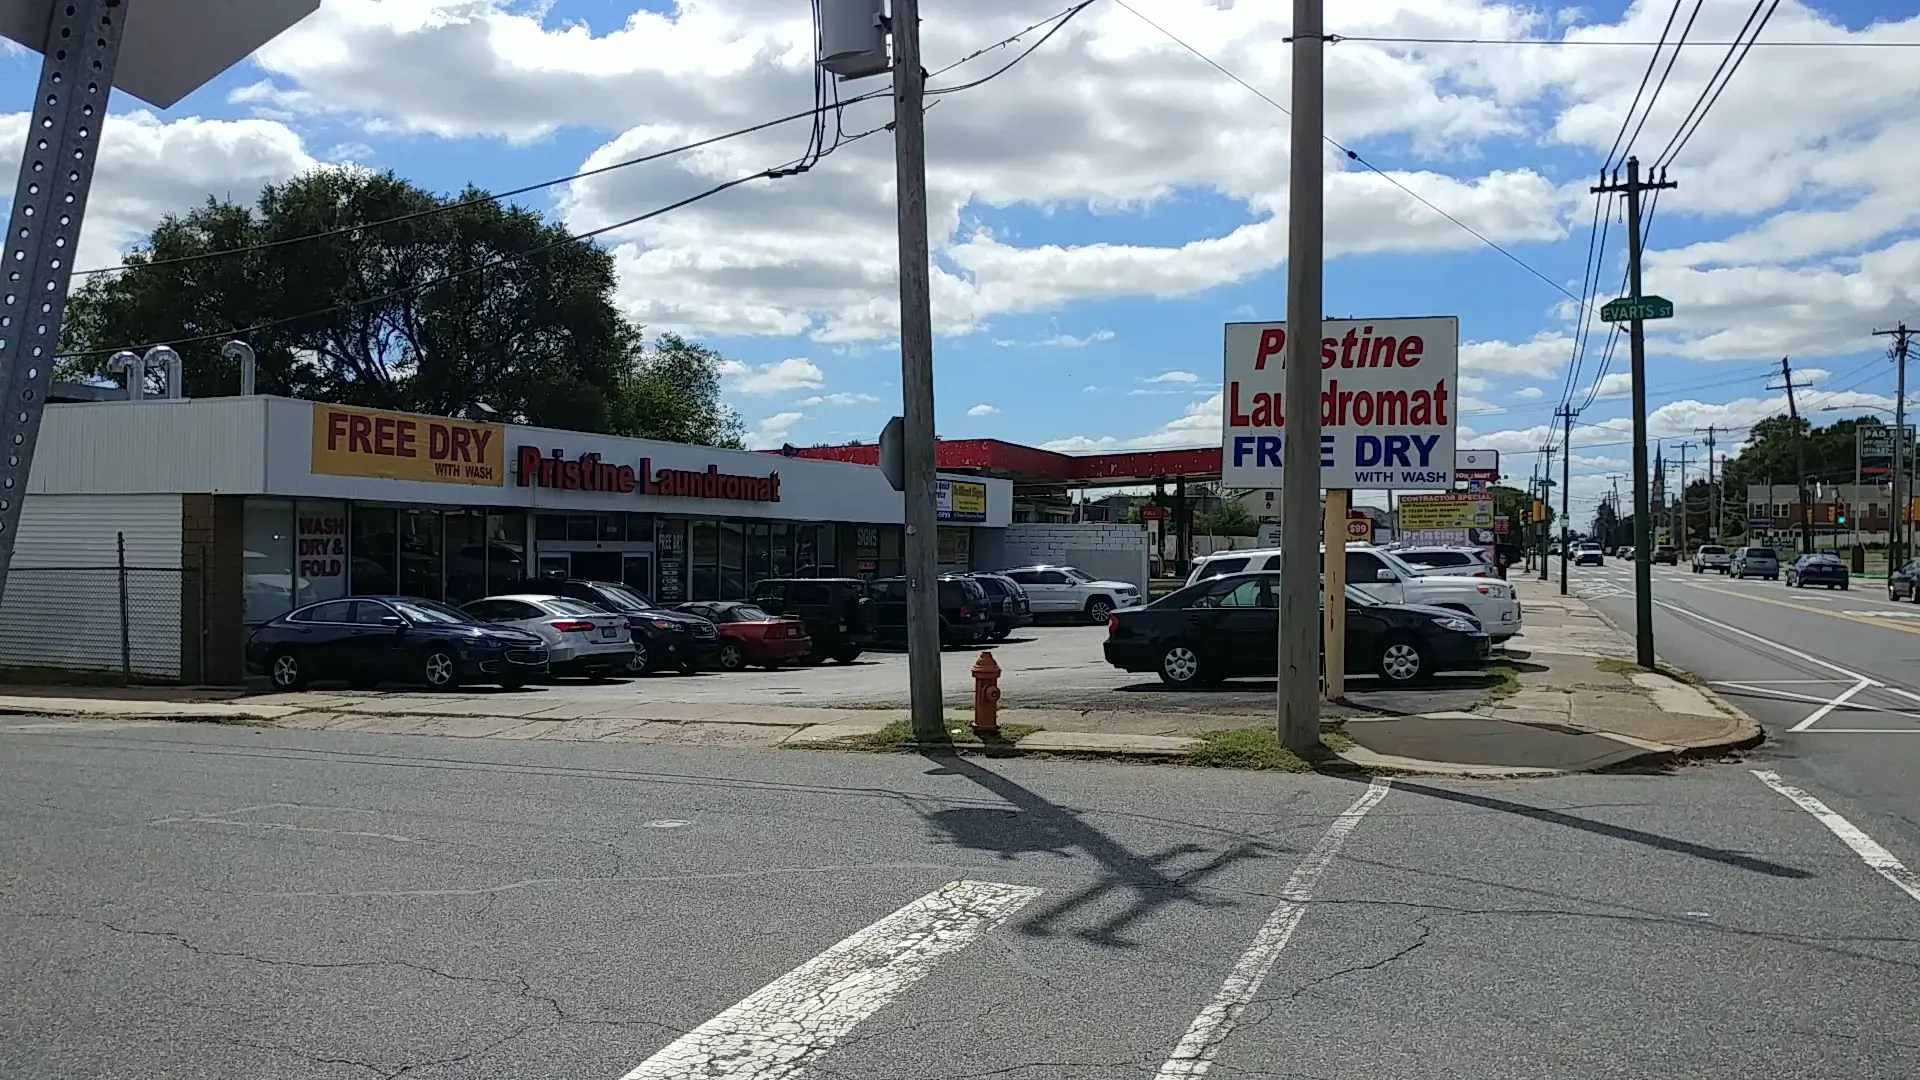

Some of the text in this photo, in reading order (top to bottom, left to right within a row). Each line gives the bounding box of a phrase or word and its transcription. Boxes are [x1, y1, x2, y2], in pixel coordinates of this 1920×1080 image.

[1603, 305, 1671, 320] EVARTS ST
[1255, 326, 1424, 370] Pstine
[1230, 378, 1448, 427] Laudromat
[327, 412, 492, 463] FREE DRY
[1865, 430, 1886, 438] PAD
[1234, 435, 1440, 467] FRE DRY
[435, 463, 492, 480] WITH WASH
[517, 445, 781, 502] Pristine Laundromat
[1355, 472, 1446, 483] WITH WASH
[1457, 493, 1491, 501] SPECIAL
[299, 517, 344, 535] WASH
[1349, 524, 1367, 534] $99
[659, 533, 683, 551] FREE DRY
[857, 528, 877, 547] SIGNS
[1402, 530, 1464, 541] Printing
[299, 538, 344, 556] DRY &
[300, 559, 342, 577] FOLD
